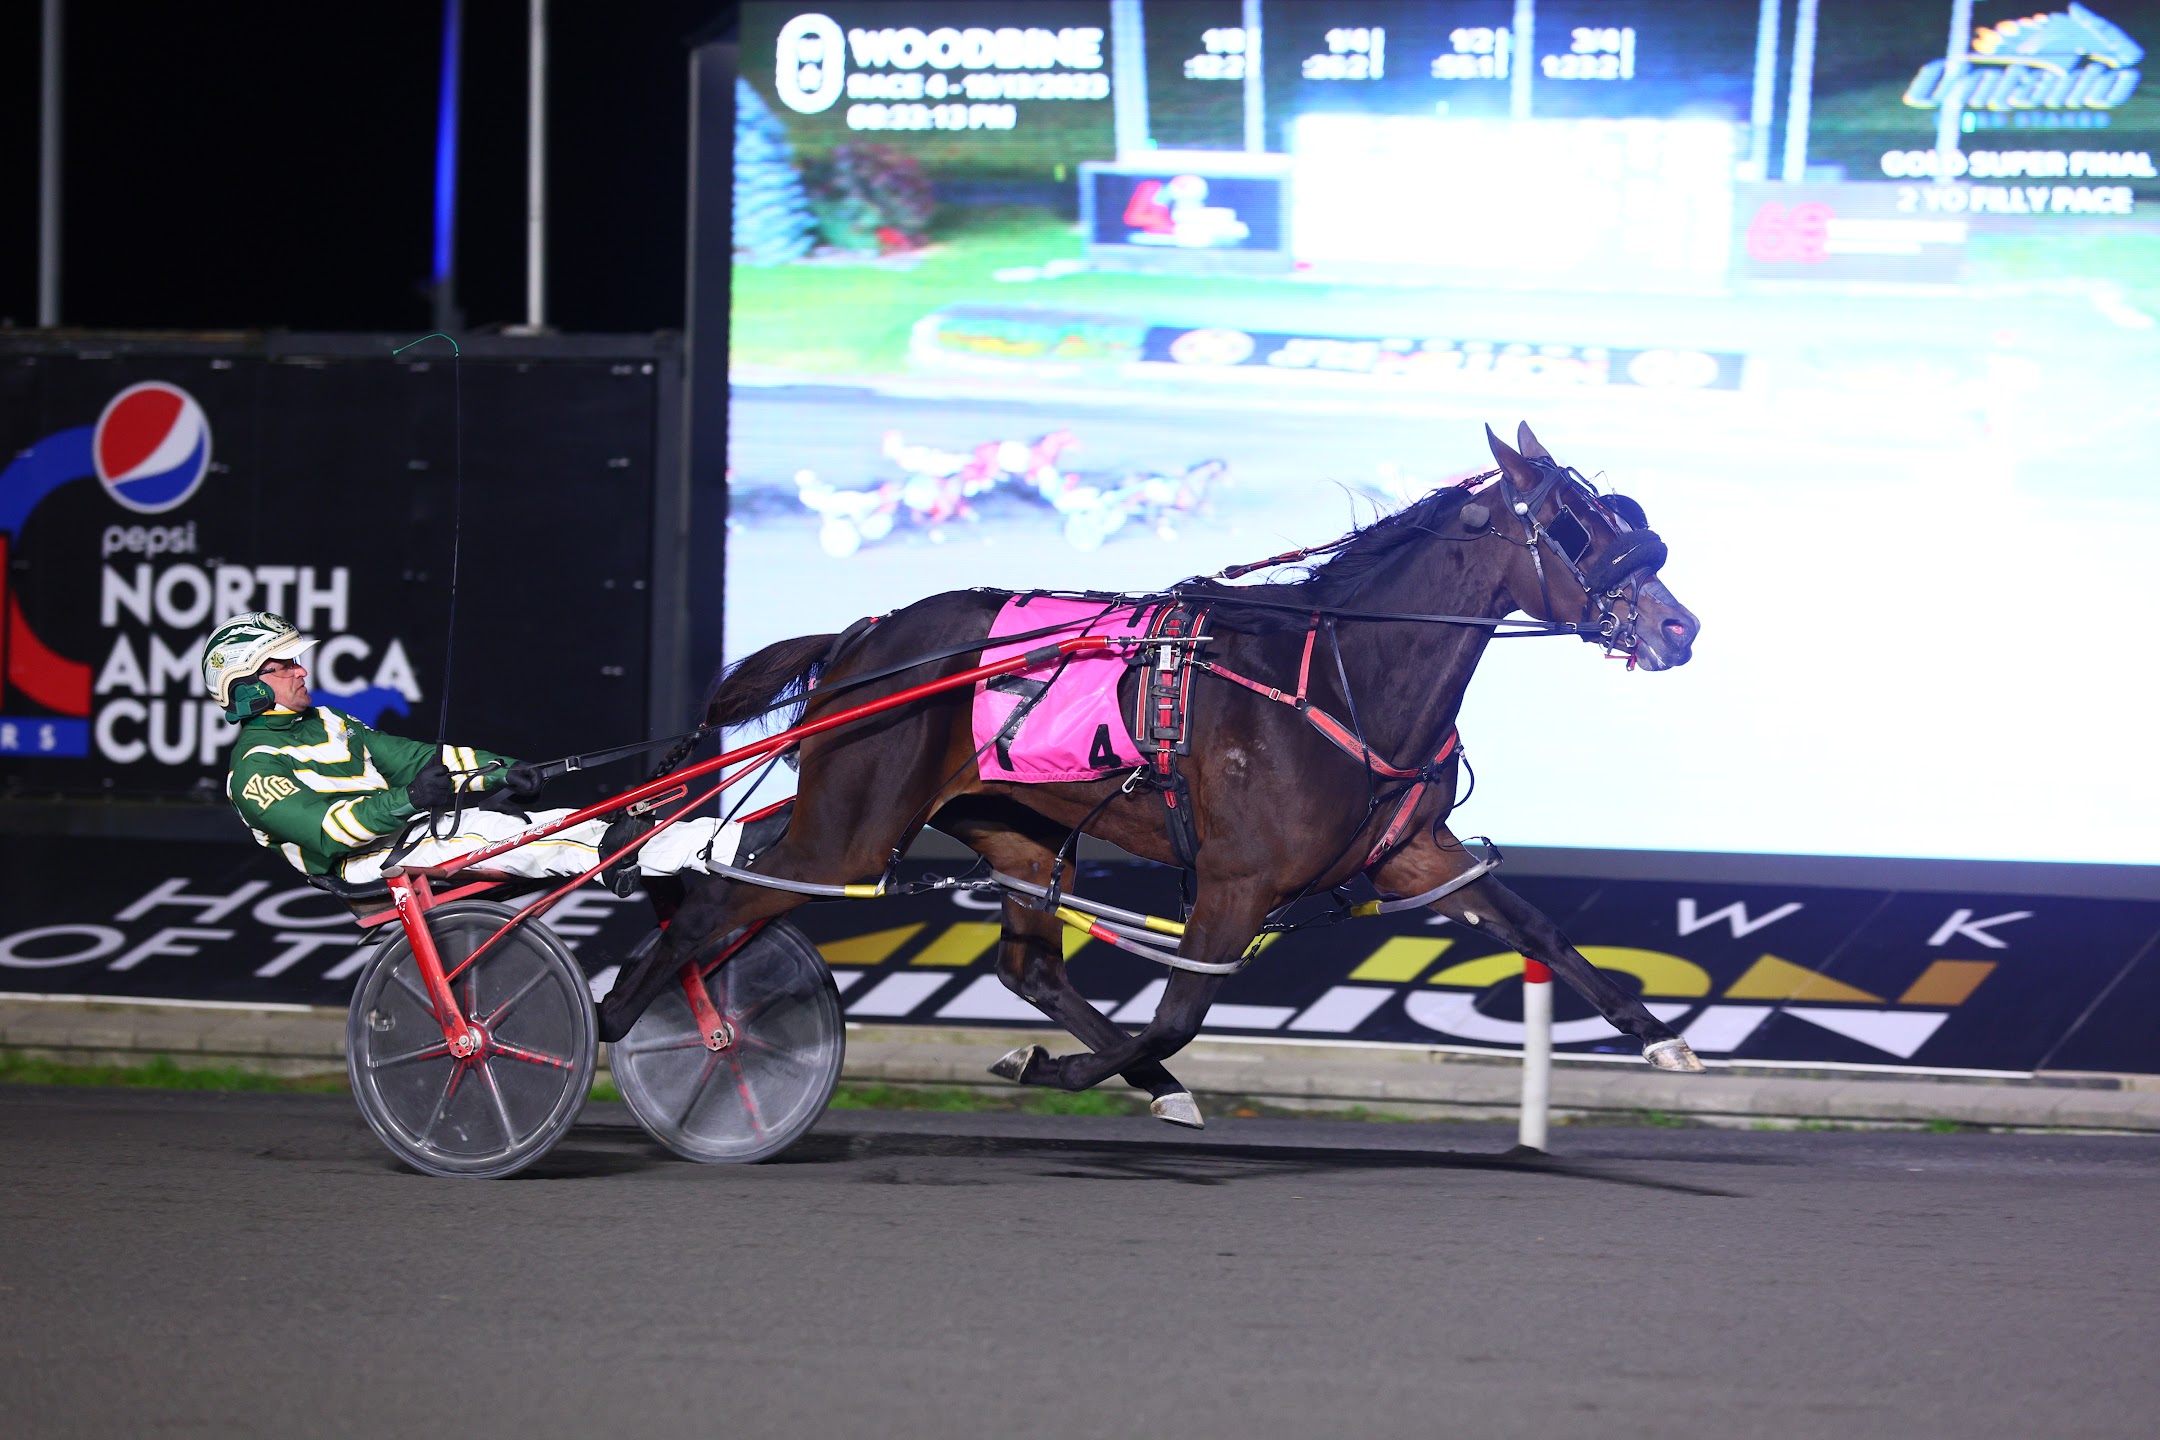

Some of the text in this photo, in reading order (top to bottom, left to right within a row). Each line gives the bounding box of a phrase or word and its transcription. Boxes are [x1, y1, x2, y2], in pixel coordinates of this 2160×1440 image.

[847, 27, 1104, 69] WOODBINE
[847, 73, 925, 99] RACE
[1881, 150, 2157, 178] GOLD SUPER FINAL
[1969, 186, 2050, 214] FILLY
[2051, 186, 2134, 214] PACE
[103, 521, 196, 559] pepsi
[101, 563, 349, 630] NORTH
[95, 632, 423, 702] AMICA
[95, 698, 242, 766] CUP
[1088, 723, 1122, 768] 4
[0, 923, 236, 971] OF
